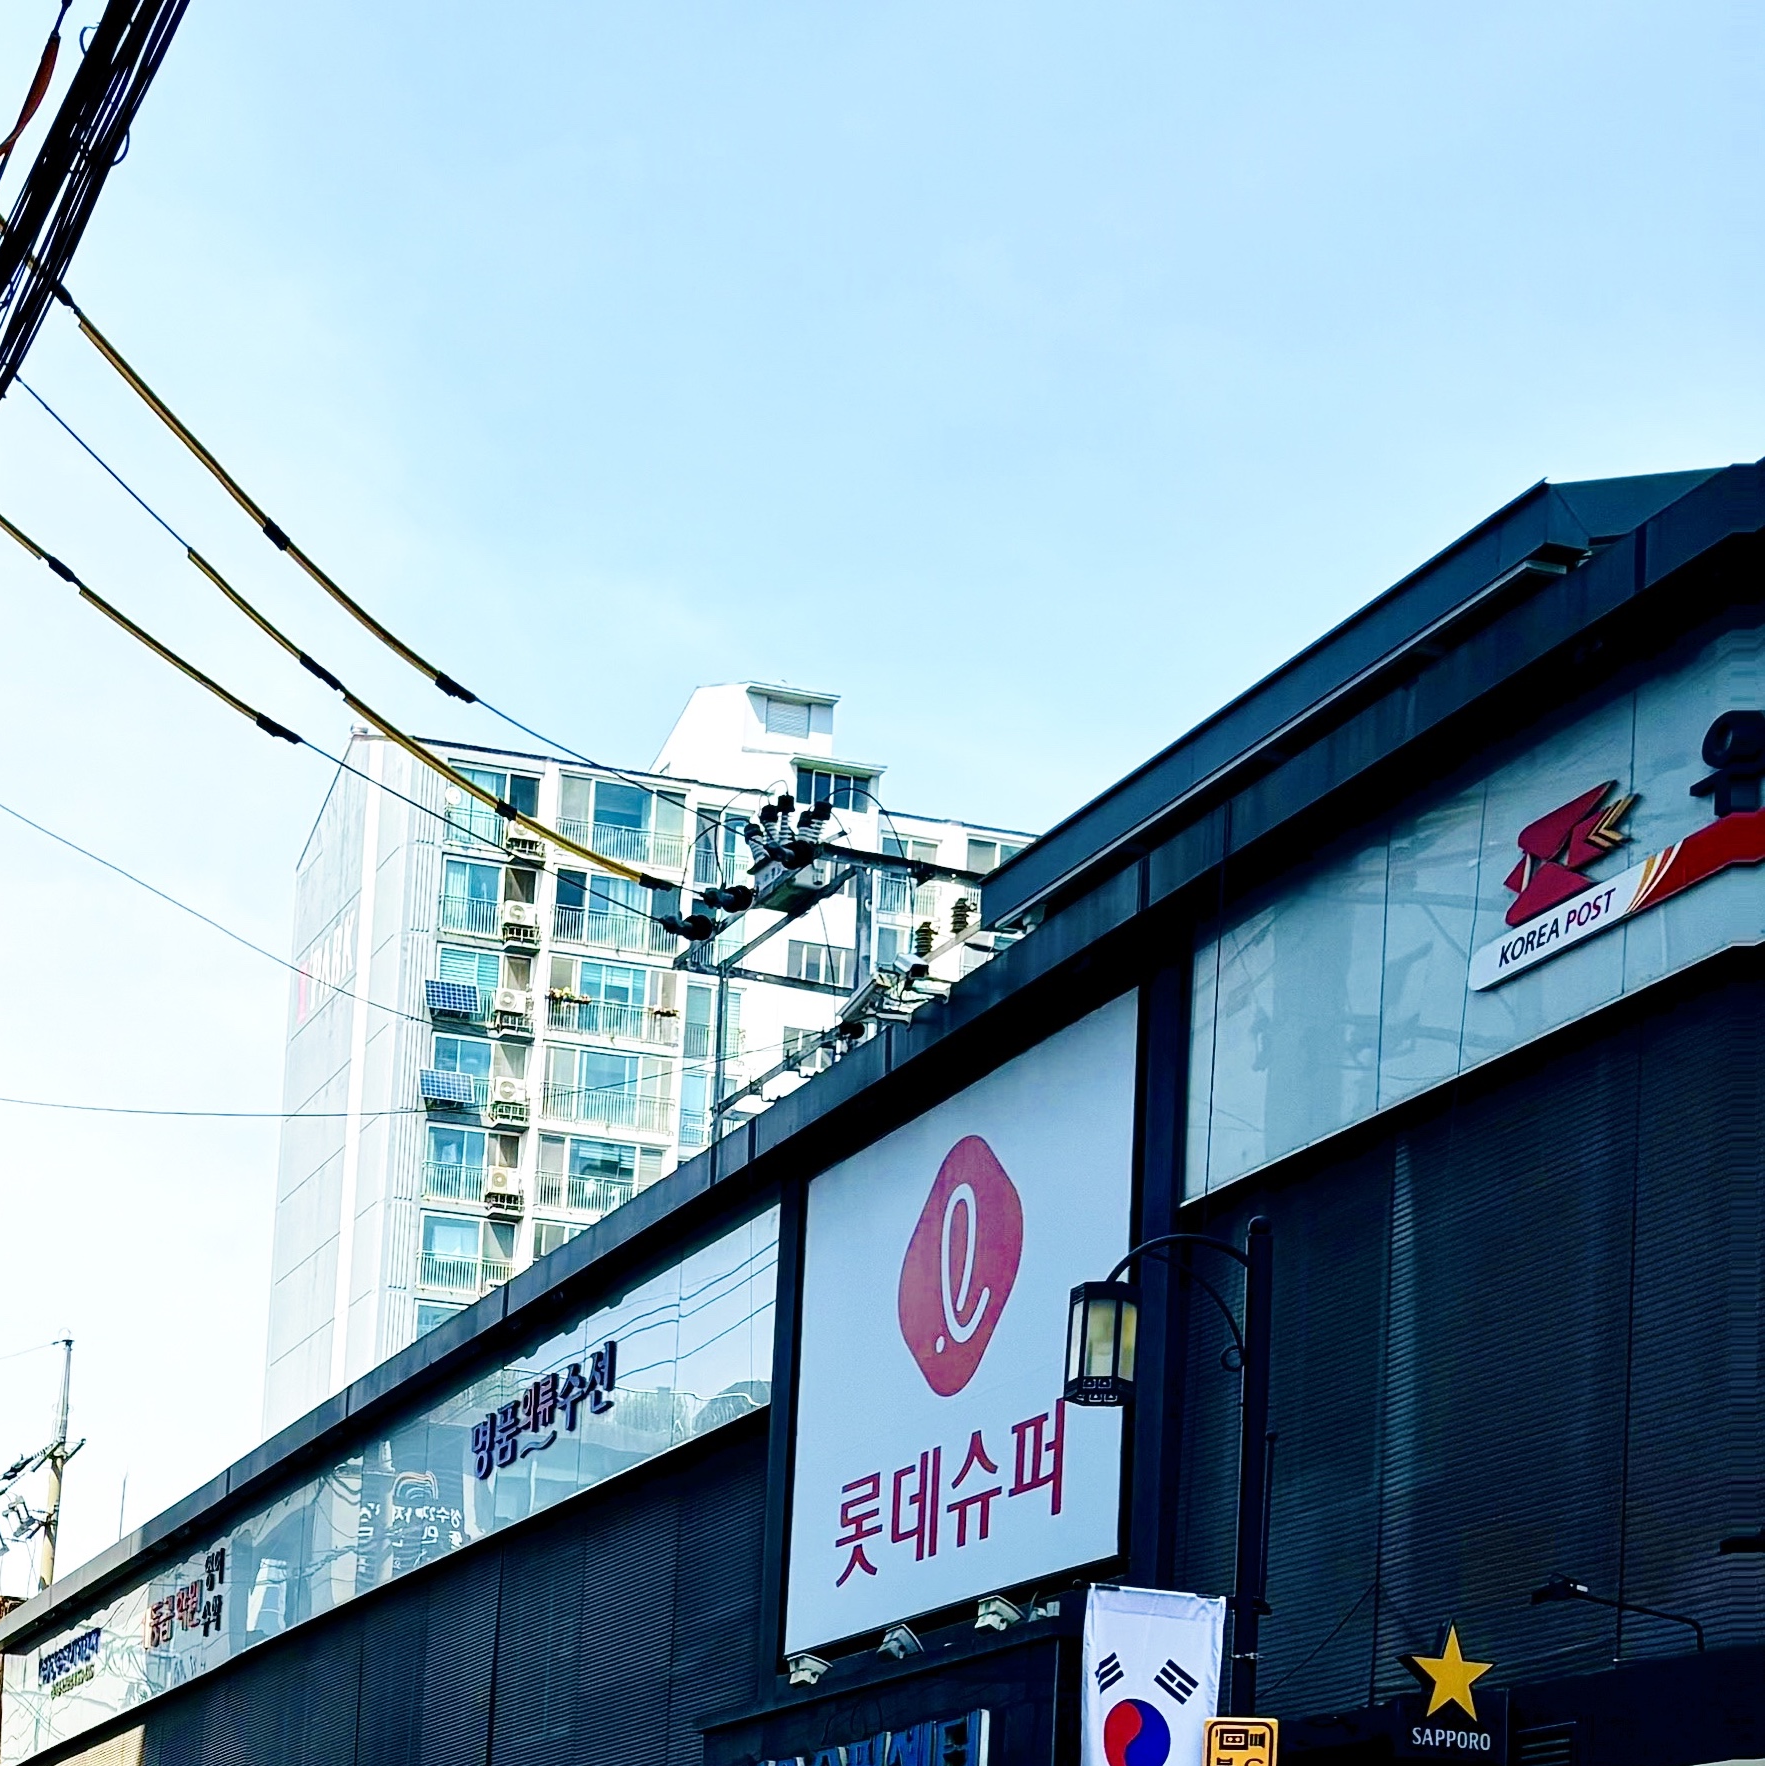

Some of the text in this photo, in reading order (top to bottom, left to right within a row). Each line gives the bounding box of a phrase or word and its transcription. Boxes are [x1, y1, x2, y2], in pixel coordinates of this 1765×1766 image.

[1497, 887, 1618, 970] KOREA POST
[835, 1398, 1066, 1588] 롯데슈퍼
[1412, 1726, 1492, 1751] SAPPORO
